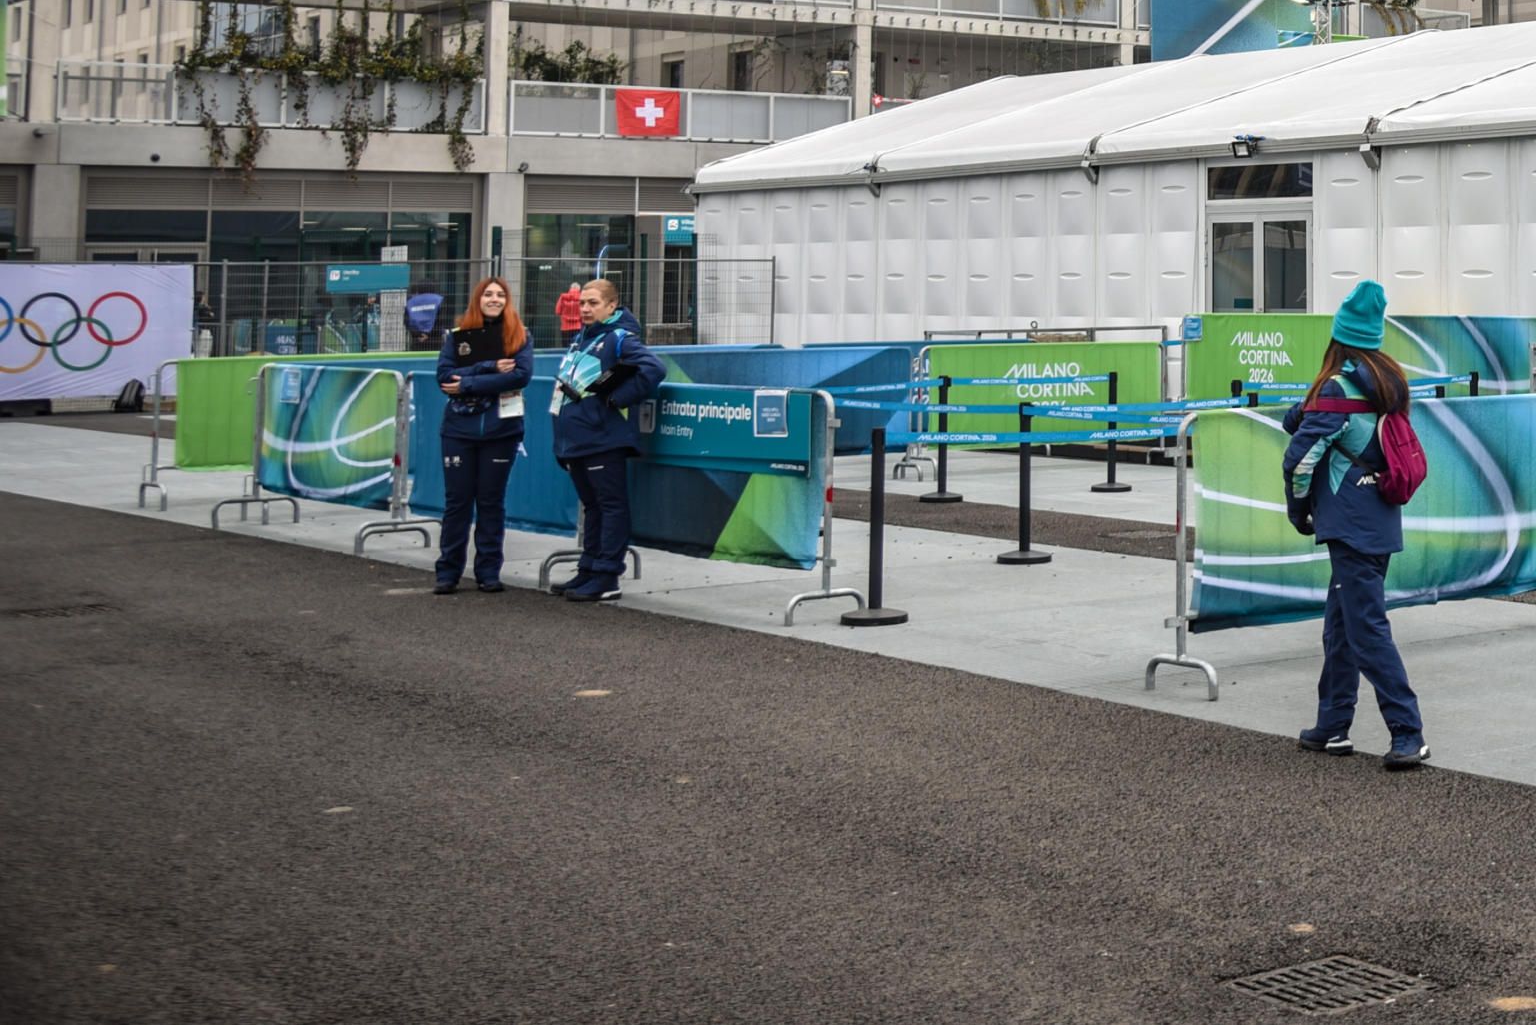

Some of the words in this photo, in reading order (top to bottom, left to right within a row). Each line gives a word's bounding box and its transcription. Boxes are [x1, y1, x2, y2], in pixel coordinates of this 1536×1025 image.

[1230, 331, 1284, 347] MILANO
[1239, 350, 1294, 366] CORTINA
[1003, 362, 1080, 379] MILANO
[1248, 368, 1274, 384] 2026
[1016, 382, 1095, 398] CORTINA
[661, 399, 696, 417] Entrata
[698, 401, 752, 425] principale
[660, 425, 676, 435] Main
[676, 425, 694, 440] Entry
[1089, 431, 1119, 439] MILANO
